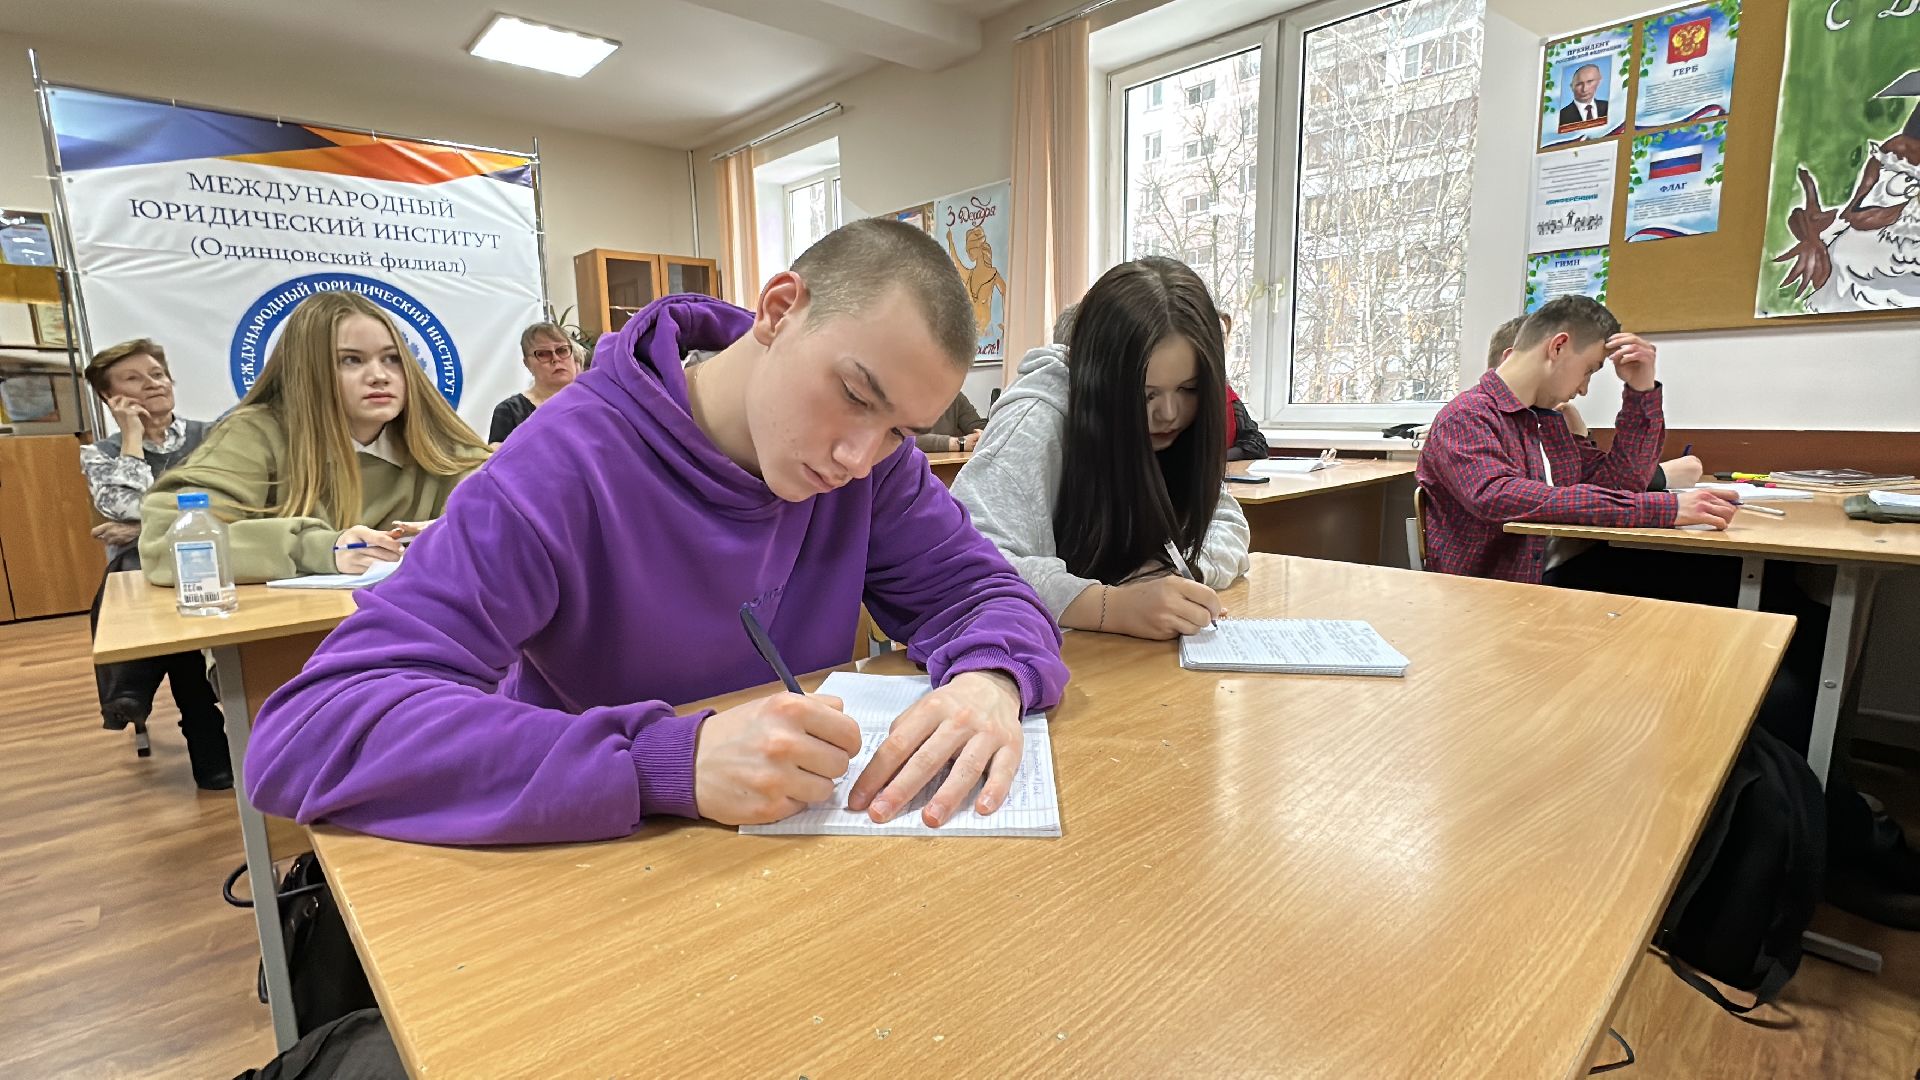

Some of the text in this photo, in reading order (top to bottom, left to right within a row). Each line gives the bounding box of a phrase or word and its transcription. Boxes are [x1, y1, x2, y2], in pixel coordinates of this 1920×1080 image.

[1567, 40, 1611, 57] ПРЕЗИДЕНТ
[1672, 64, 1699, 77] ГЕРБ
[187, 171, 455, 219] МЕЖДУНАРОДНЫЙ
[1660, 182, 1688, 193] ФЛАГ
[129, 199, 501, 249] ЮРИДИЧЕСКИЙ ИНСТИТУТ
[946, 205, 955, 227] 3
[191, 235, 467, 277] (Одинцовский филиал)
[1554, 258, 1580, 269] ГИМН
[313, 280, 431, 326] ЮРИДИЧЕСКИЙ
[426, 326, 457, 395] ИНСТИТУТ
